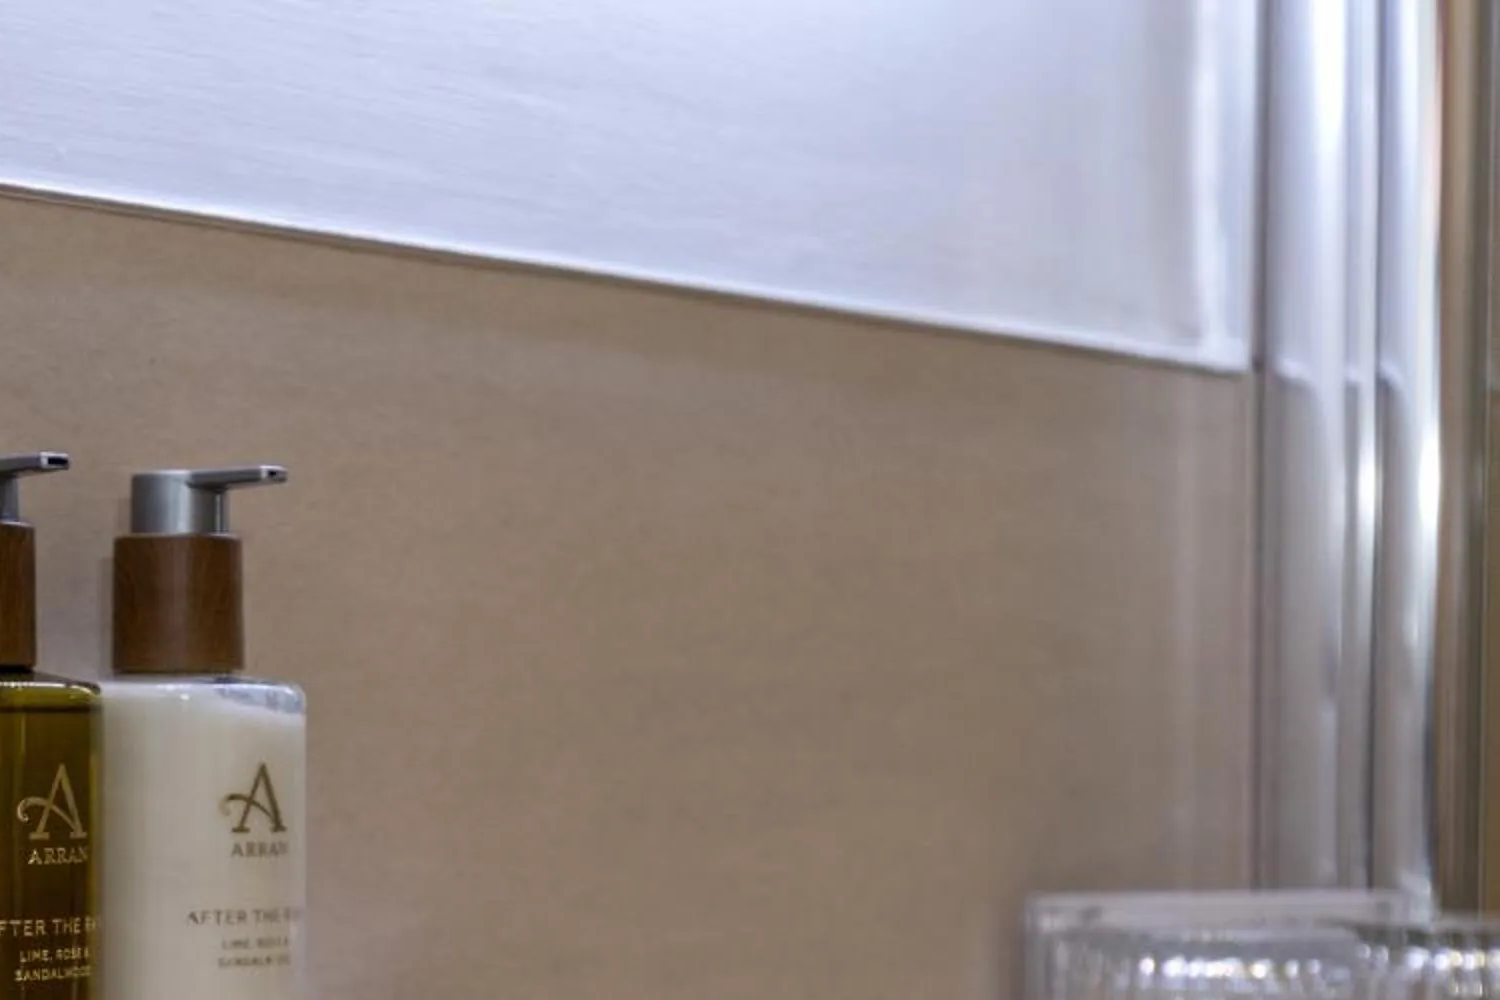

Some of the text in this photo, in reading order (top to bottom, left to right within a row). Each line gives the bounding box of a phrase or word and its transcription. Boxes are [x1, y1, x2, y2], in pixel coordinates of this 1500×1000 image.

[17, 763, 88, 840] A
[219, 762, 288, 834] A
[52, 916, 81, 936] THE
[187, 909, 247, 926] AFTER
